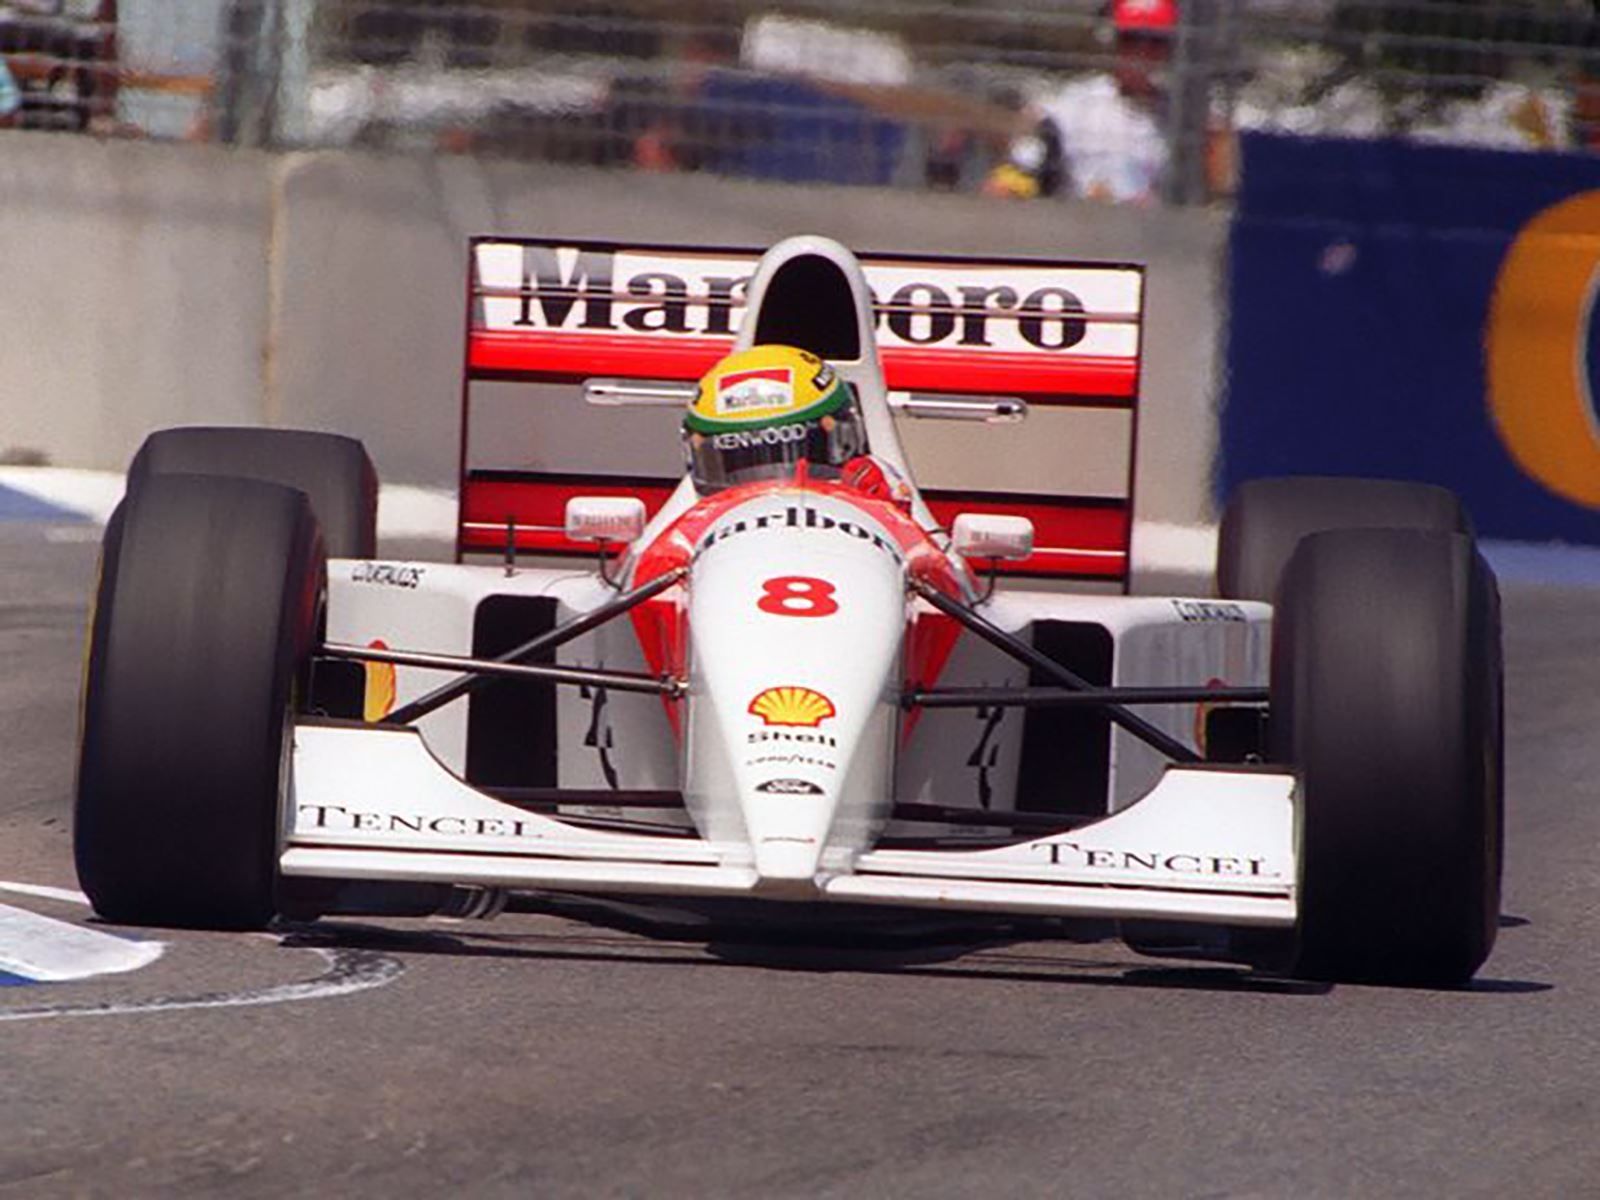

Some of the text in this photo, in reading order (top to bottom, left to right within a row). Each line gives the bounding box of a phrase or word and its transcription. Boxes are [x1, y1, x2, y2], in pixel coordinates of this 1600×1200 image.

[513, 246, 1087, 351] Maroro
[691, 507, 902, 566] arlbor
[757, 576, 839, 618] 8
[748, 732, 836, 748] Shell
[299, 804, 543, 838] TENCEL
[1031, 843, 1281, 878] TENCEL
